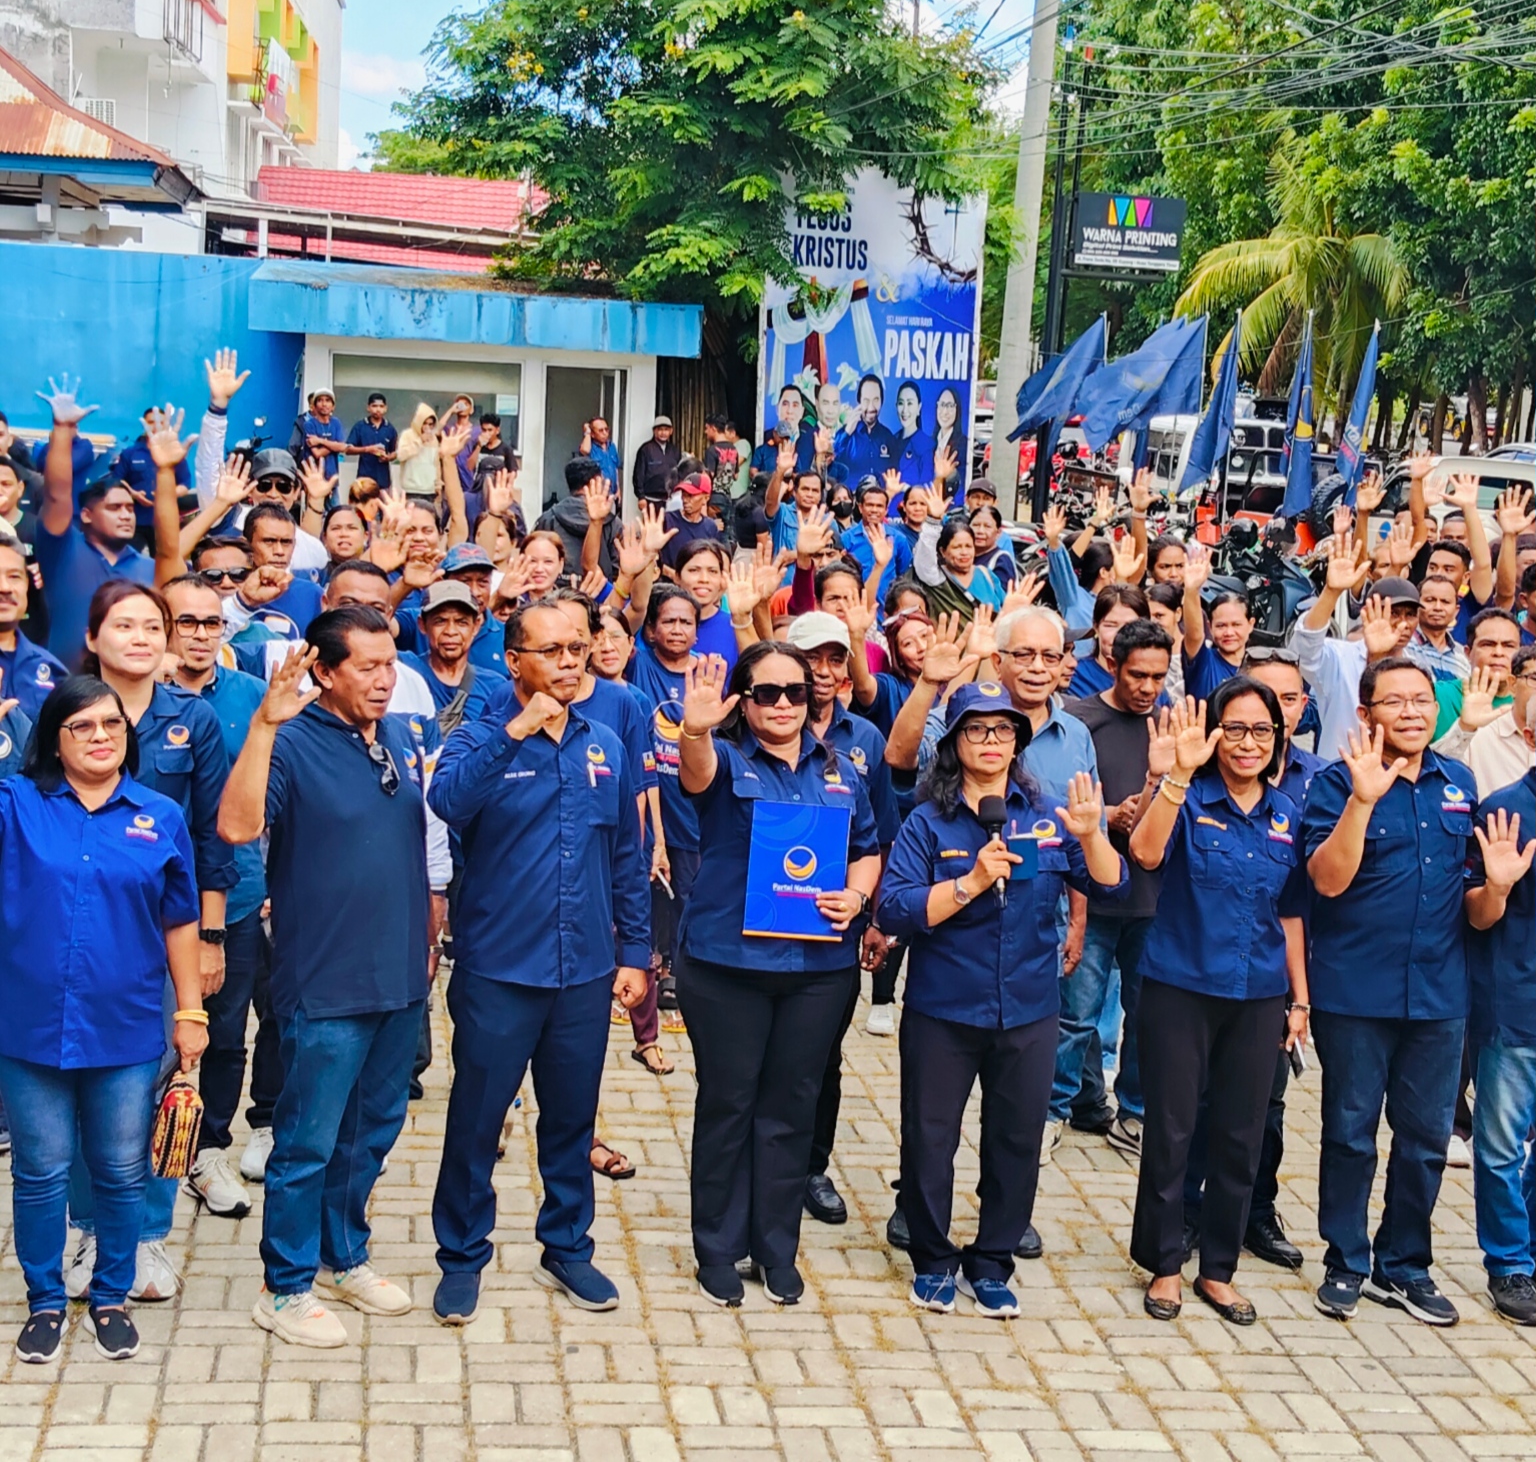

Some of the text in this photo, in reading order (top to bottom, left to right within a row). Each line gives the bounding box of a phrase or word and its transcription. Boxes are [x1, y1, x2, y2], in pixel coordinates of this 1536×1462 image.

[1082, 227, 1178, 247] WARNA PRINTING
[793, 234, 868, 271] KRISTUS
[883, 329, 970, 381] PASKAH
[772, 882, 823, 895] Partai NasDem
